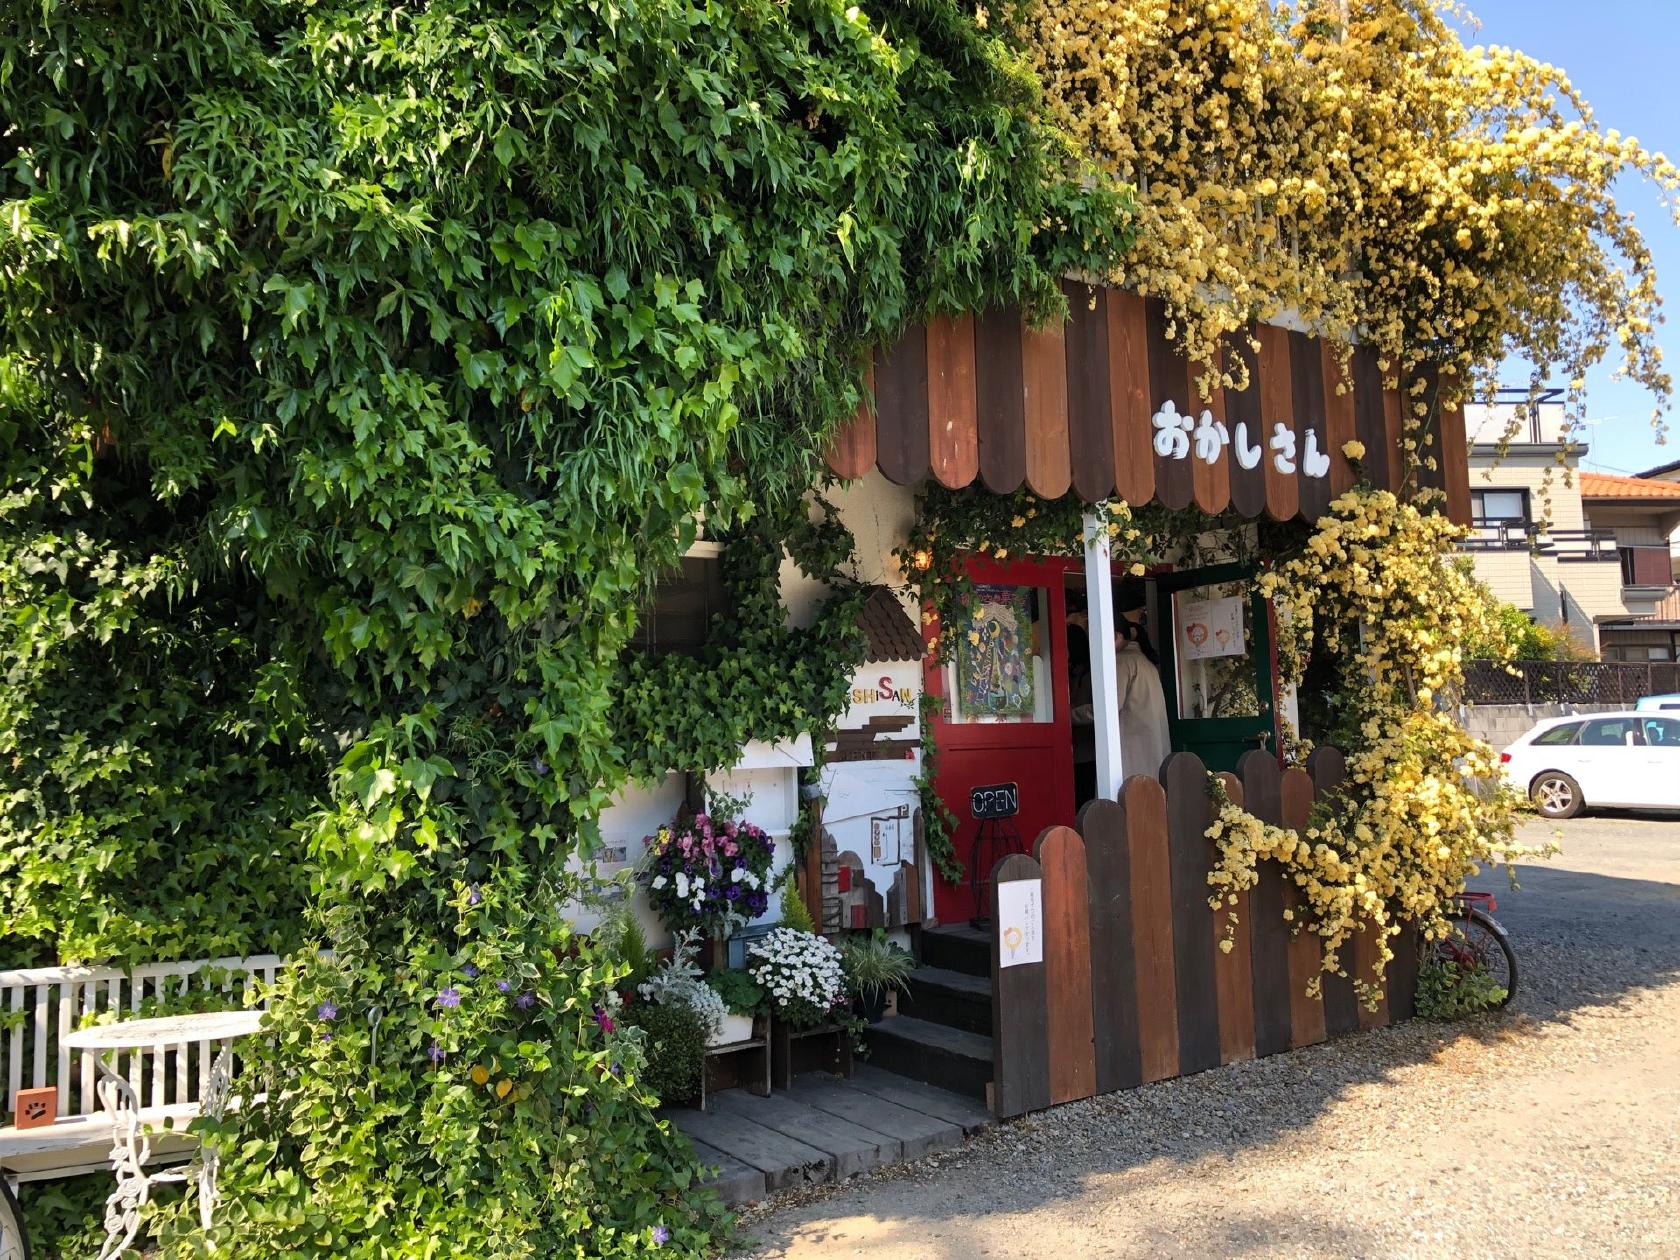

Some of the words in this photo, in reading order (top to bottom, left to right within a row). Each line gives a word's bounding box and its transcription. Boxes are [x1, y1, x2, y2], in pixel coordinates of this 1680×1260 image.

[1152, 400, 1330, 478] おかしさん
[900, 805, 908, 816] P
[973, 788, 1016, 812] OPEN
